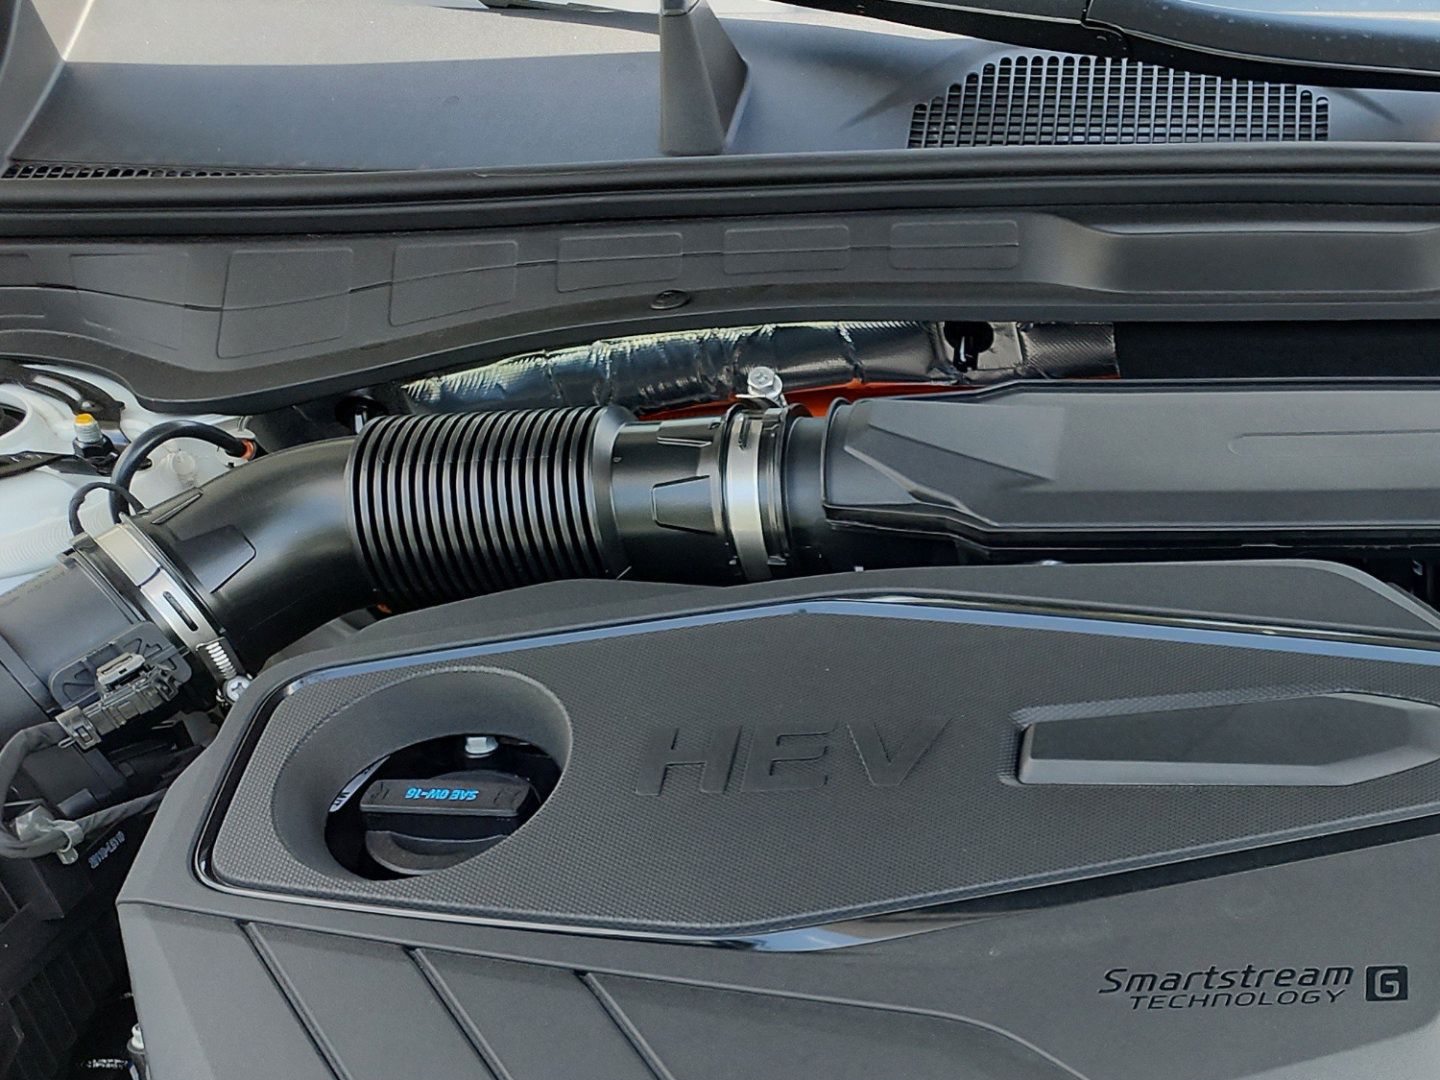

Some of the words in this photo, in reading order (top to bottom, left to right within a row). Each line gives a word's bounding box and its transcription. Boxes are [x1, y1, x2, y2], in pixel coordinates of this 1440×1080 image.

[636, 719, 952, 798] HEV
[450, 788, 479, 800] SAE
[1098, 964, 1355, 993] Smartstream
[1372, 967, 1402, 999] G
[1130, 989, 1346, 1010] TECHNOLOGY
